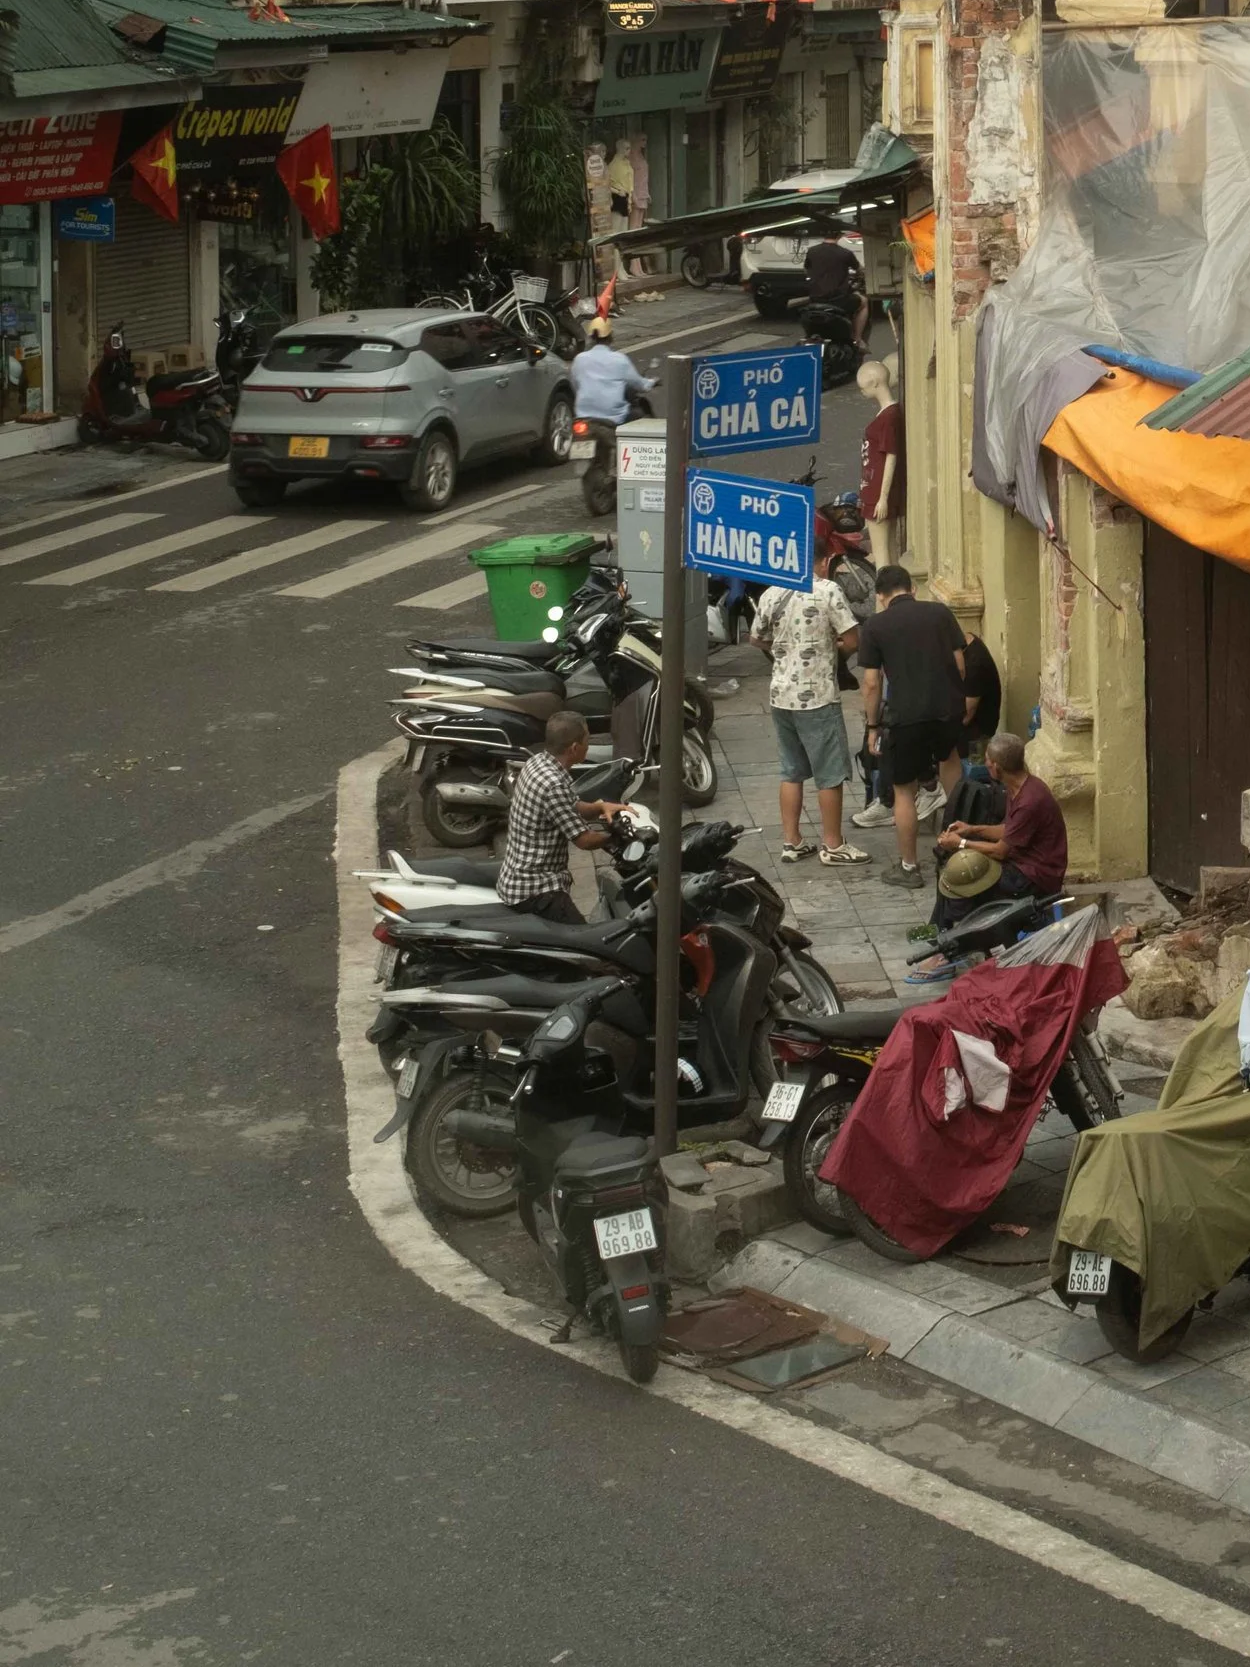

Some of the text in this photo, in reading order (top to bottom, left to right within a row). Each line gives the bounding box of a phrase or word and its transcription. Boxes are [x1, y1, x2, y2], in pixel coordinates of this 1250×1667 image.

[617, 42, 652, 79] GIA
[240, 96, 297, 136] world
[76, 222, 111, 231] TOURISTS
[744, 359, 785, 386] PHỐ
[700, 387, 808, 439] CHẢ CÁ
[741, 494, 780, 517] PHỐ
[696, 517, 800, 574] HÀNG CÁ
[603, 1212, 645, 1237] 29-AB
[602, 1230, 653, 1256] 969.88
[1069, 1273, 1106, 1291] 696.88
